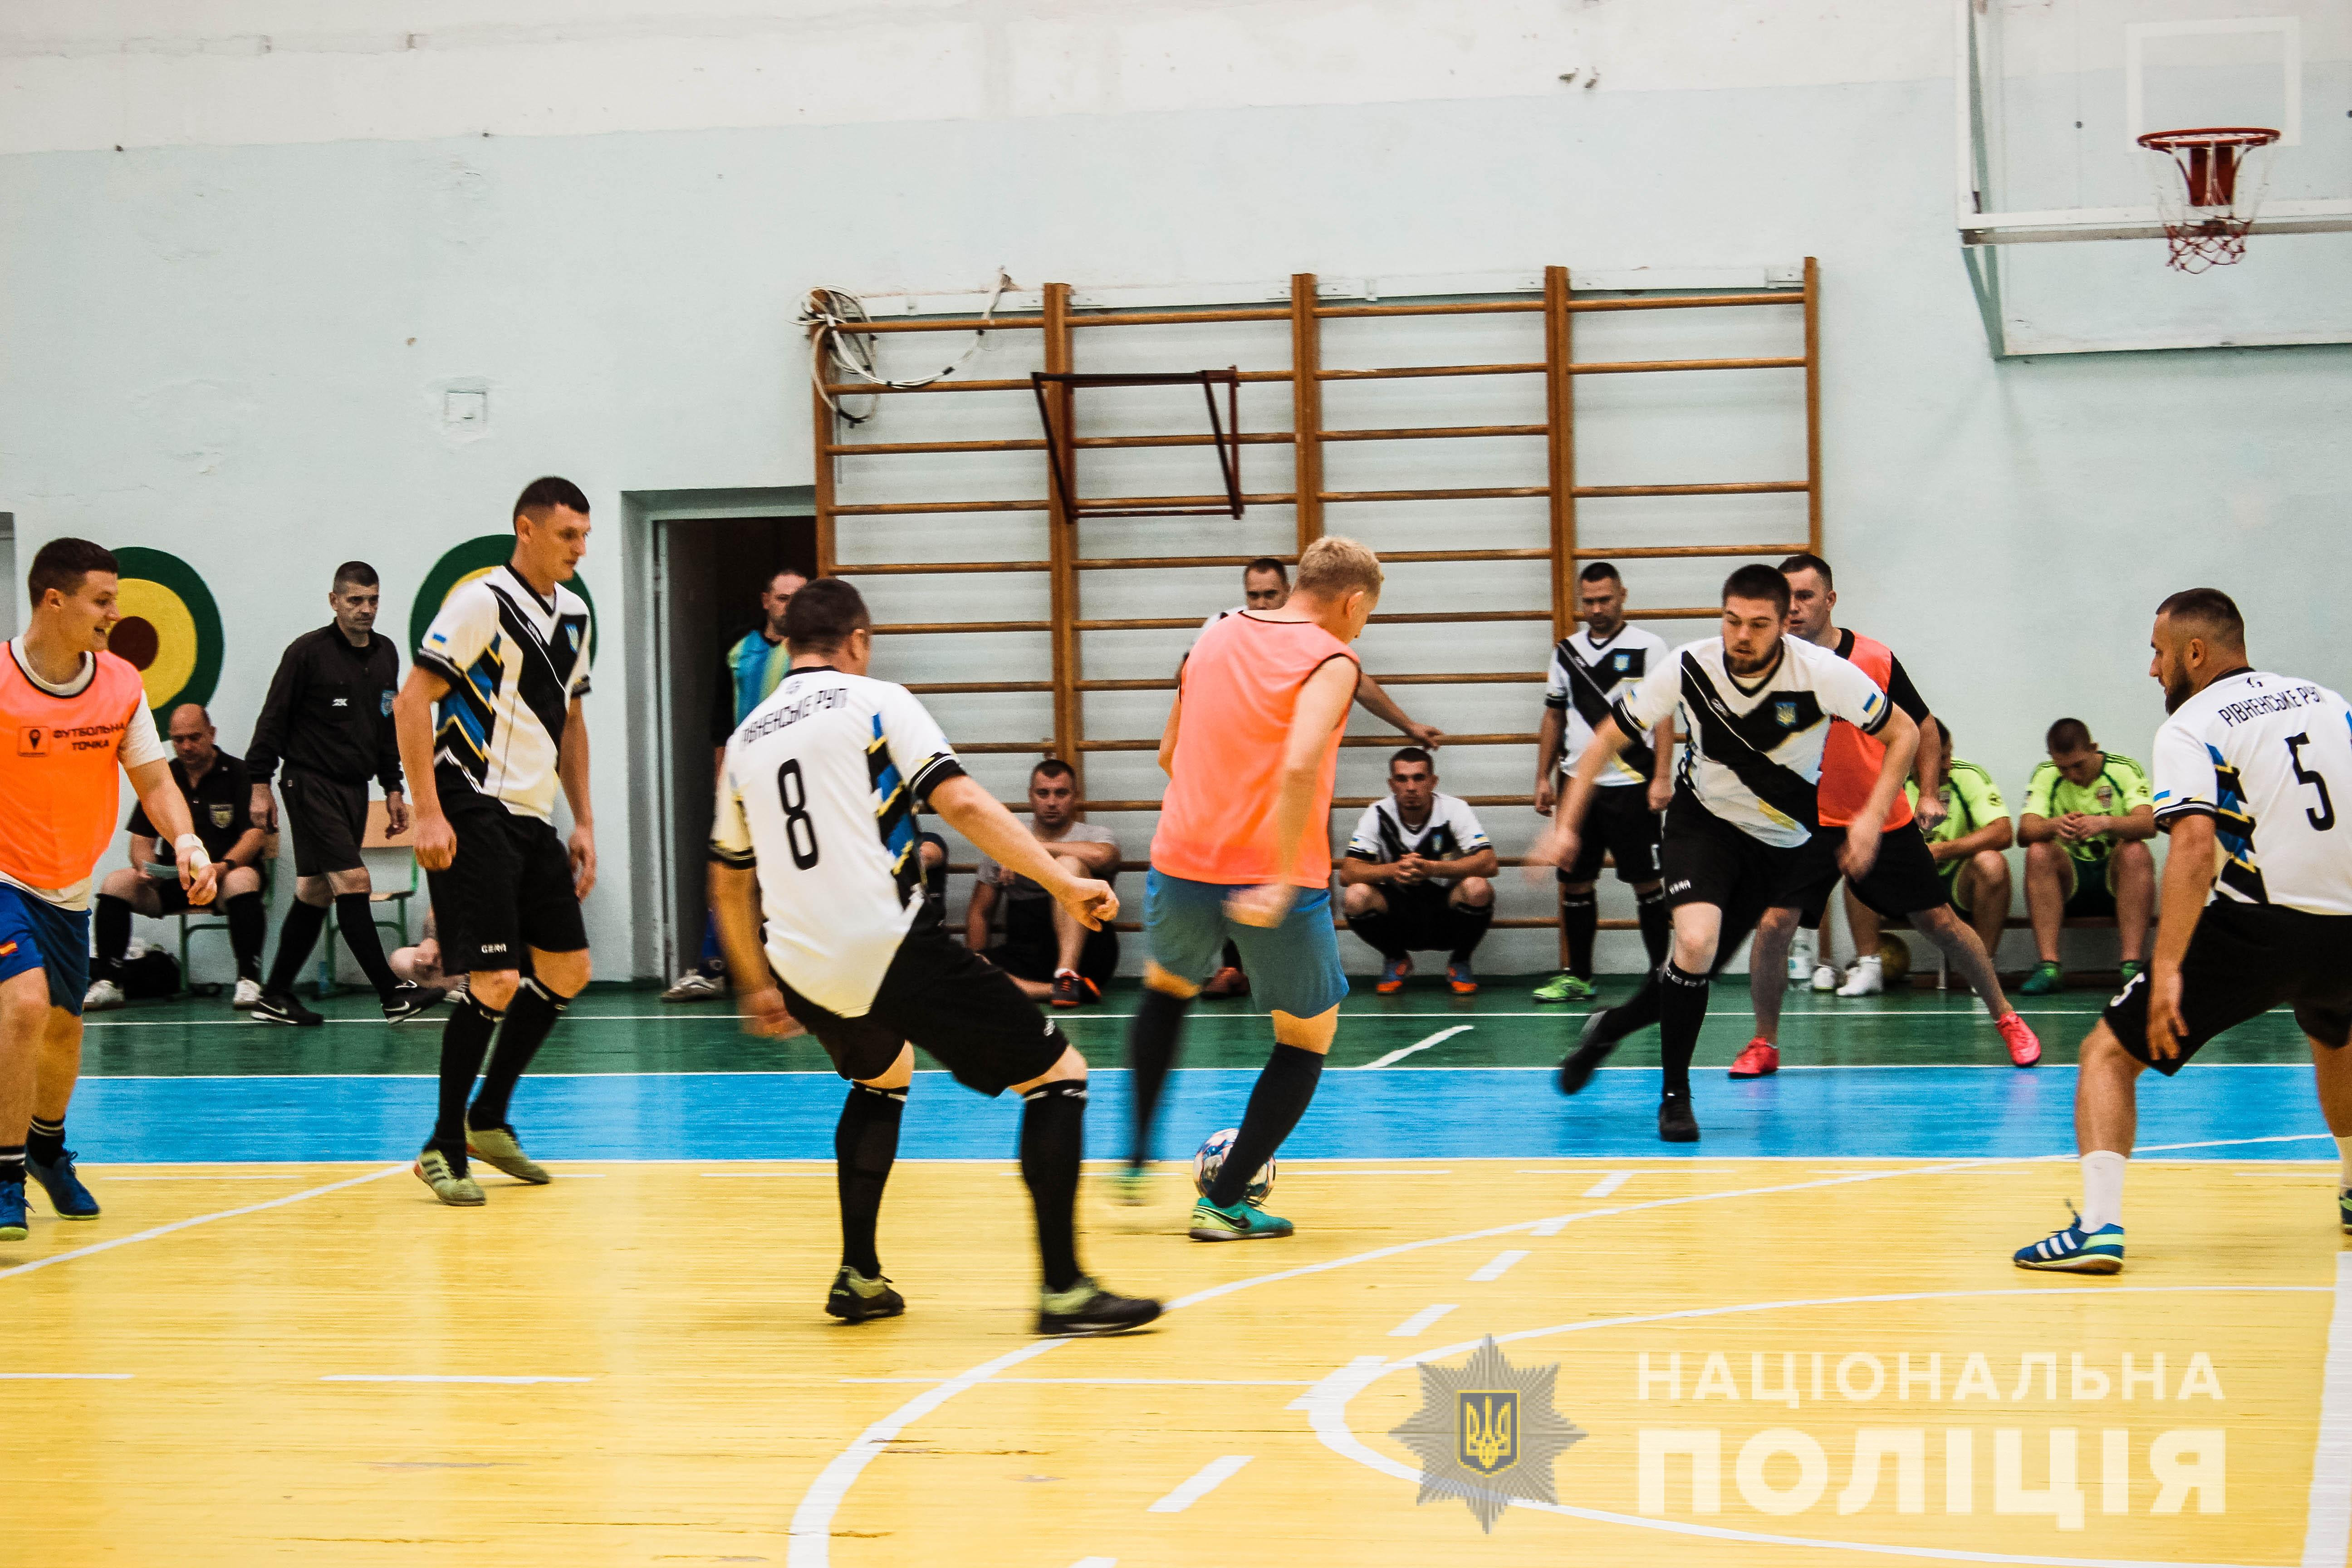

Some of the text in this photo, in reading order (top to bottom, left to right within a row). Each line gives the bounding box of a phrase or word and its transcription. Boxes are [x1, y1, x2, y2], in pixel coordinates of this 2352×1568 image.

[2218, 690, 2302, 727] РІВНЕНСЬКЕ
[778, 758, 818, 871] 8
[2284, 732, 2335, 831] 5
